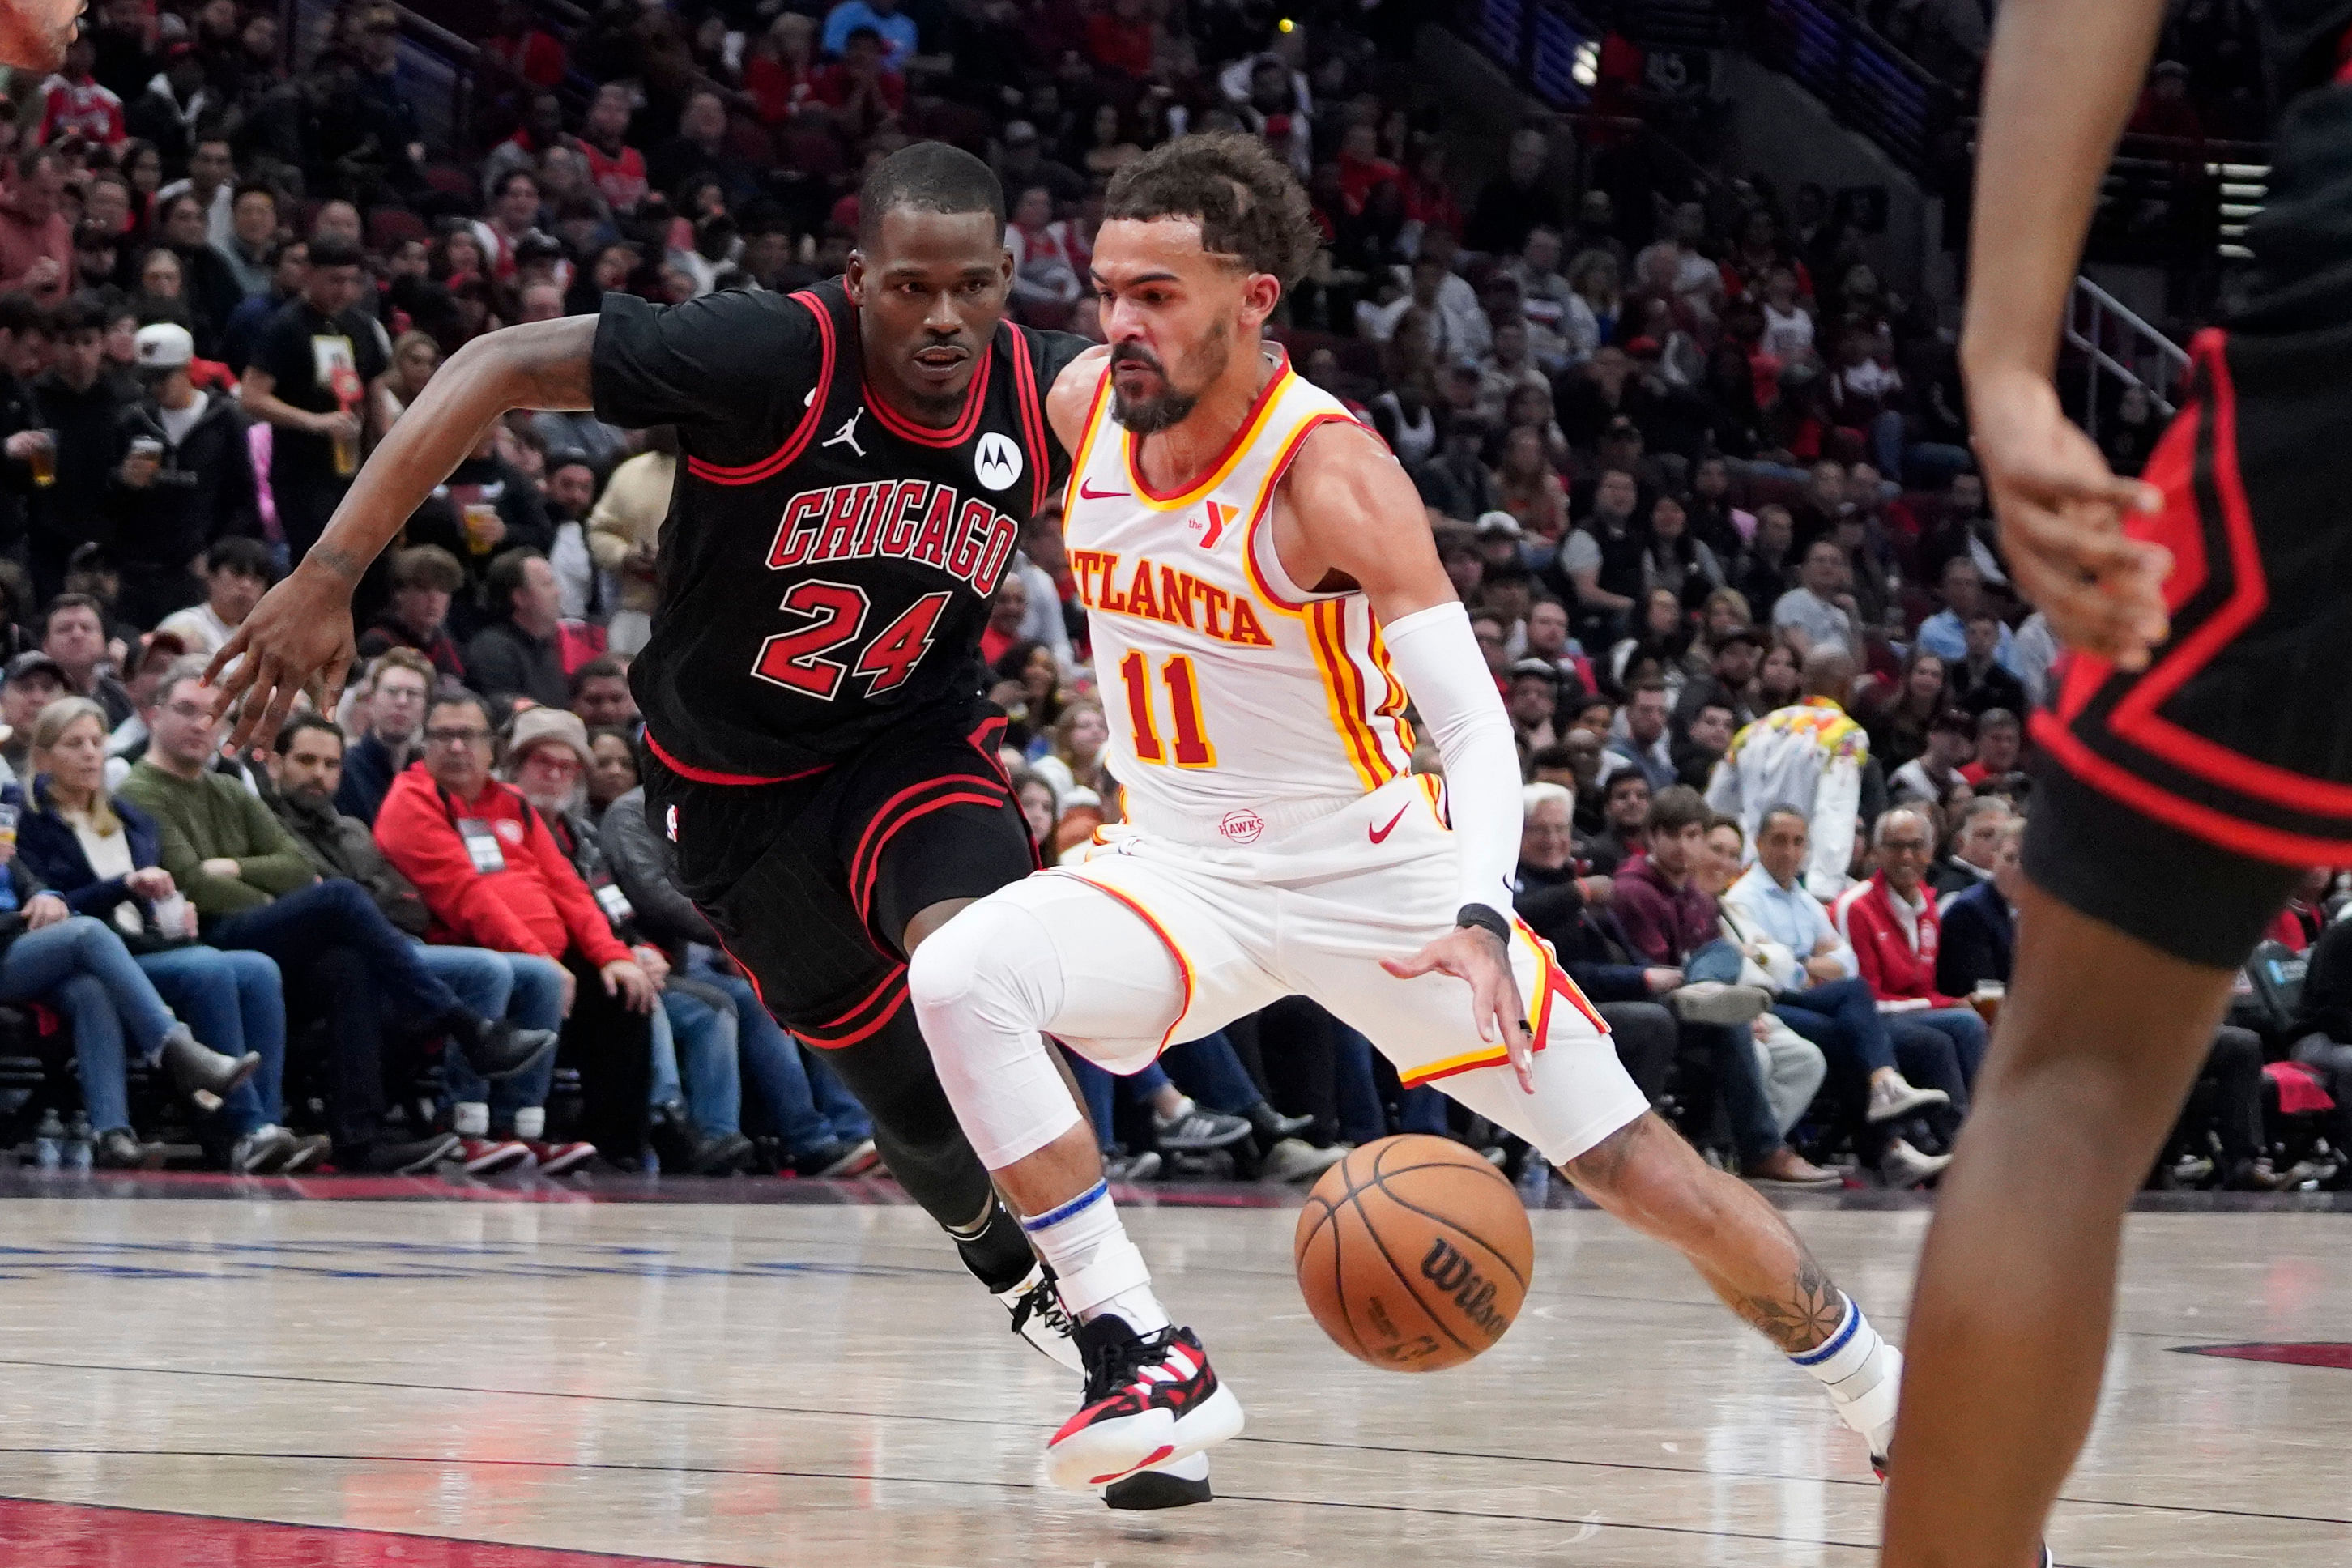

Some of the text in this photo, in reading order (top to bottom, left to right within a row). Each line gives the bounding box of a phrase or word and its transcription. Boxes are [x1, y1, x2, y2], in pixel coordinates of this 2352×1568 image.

[765, 479, 1018, 599] CHICAGO
[1187, 518, 1203, 531] the
[750, 578, 953, 701] 24
[1065, 548, 1275, 649] TLANTA
[1119, 648, 1218, 769] 11
[1218, 818, 1264, 835] HAWKS
